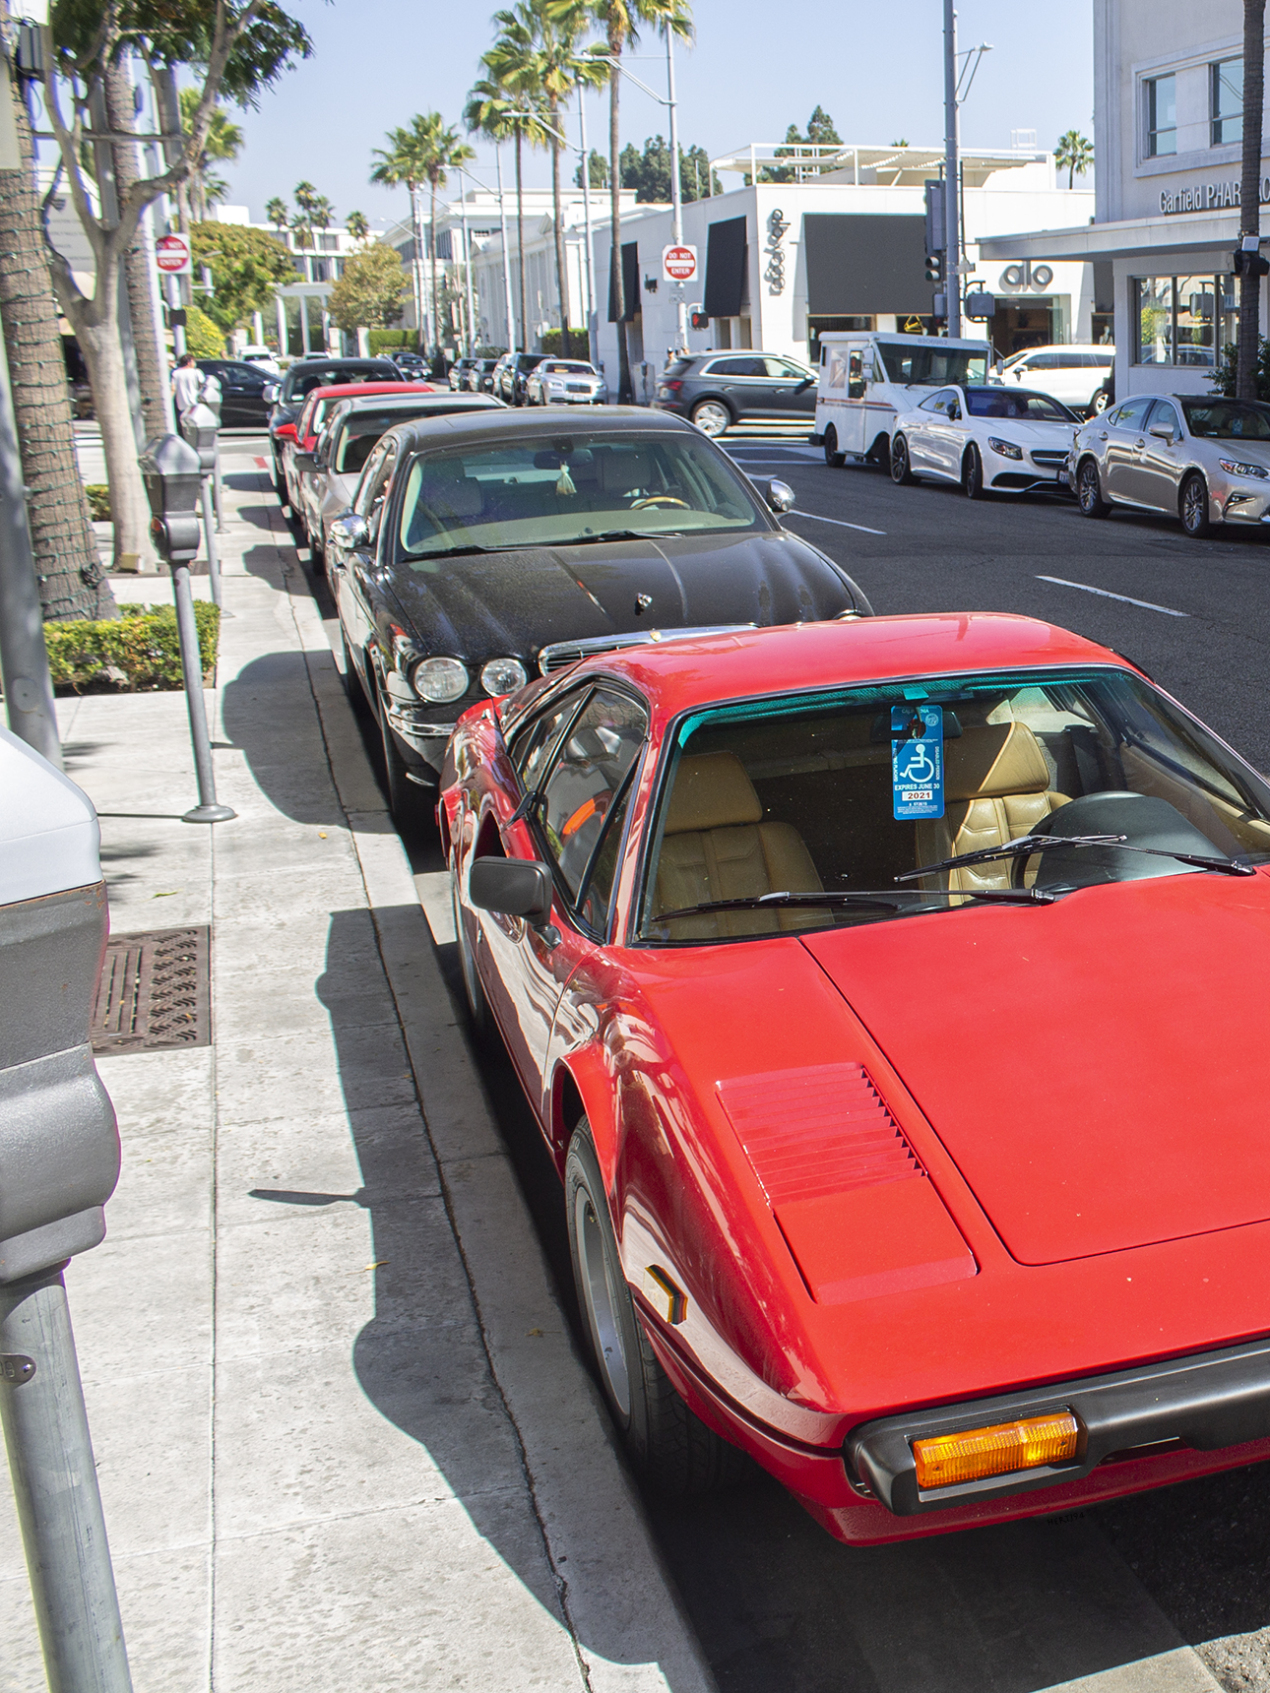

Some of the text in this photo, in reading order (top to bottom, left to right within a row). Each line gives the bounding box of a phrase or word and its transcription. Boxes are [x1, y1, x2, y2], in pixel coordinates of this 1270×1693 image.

[1159, 186, 1203, 213] Garfield
[167, 241, 183, 249] NOT
[159, 258, 183, 266] ENTER
[1001, 260, 1054, 288] alo
